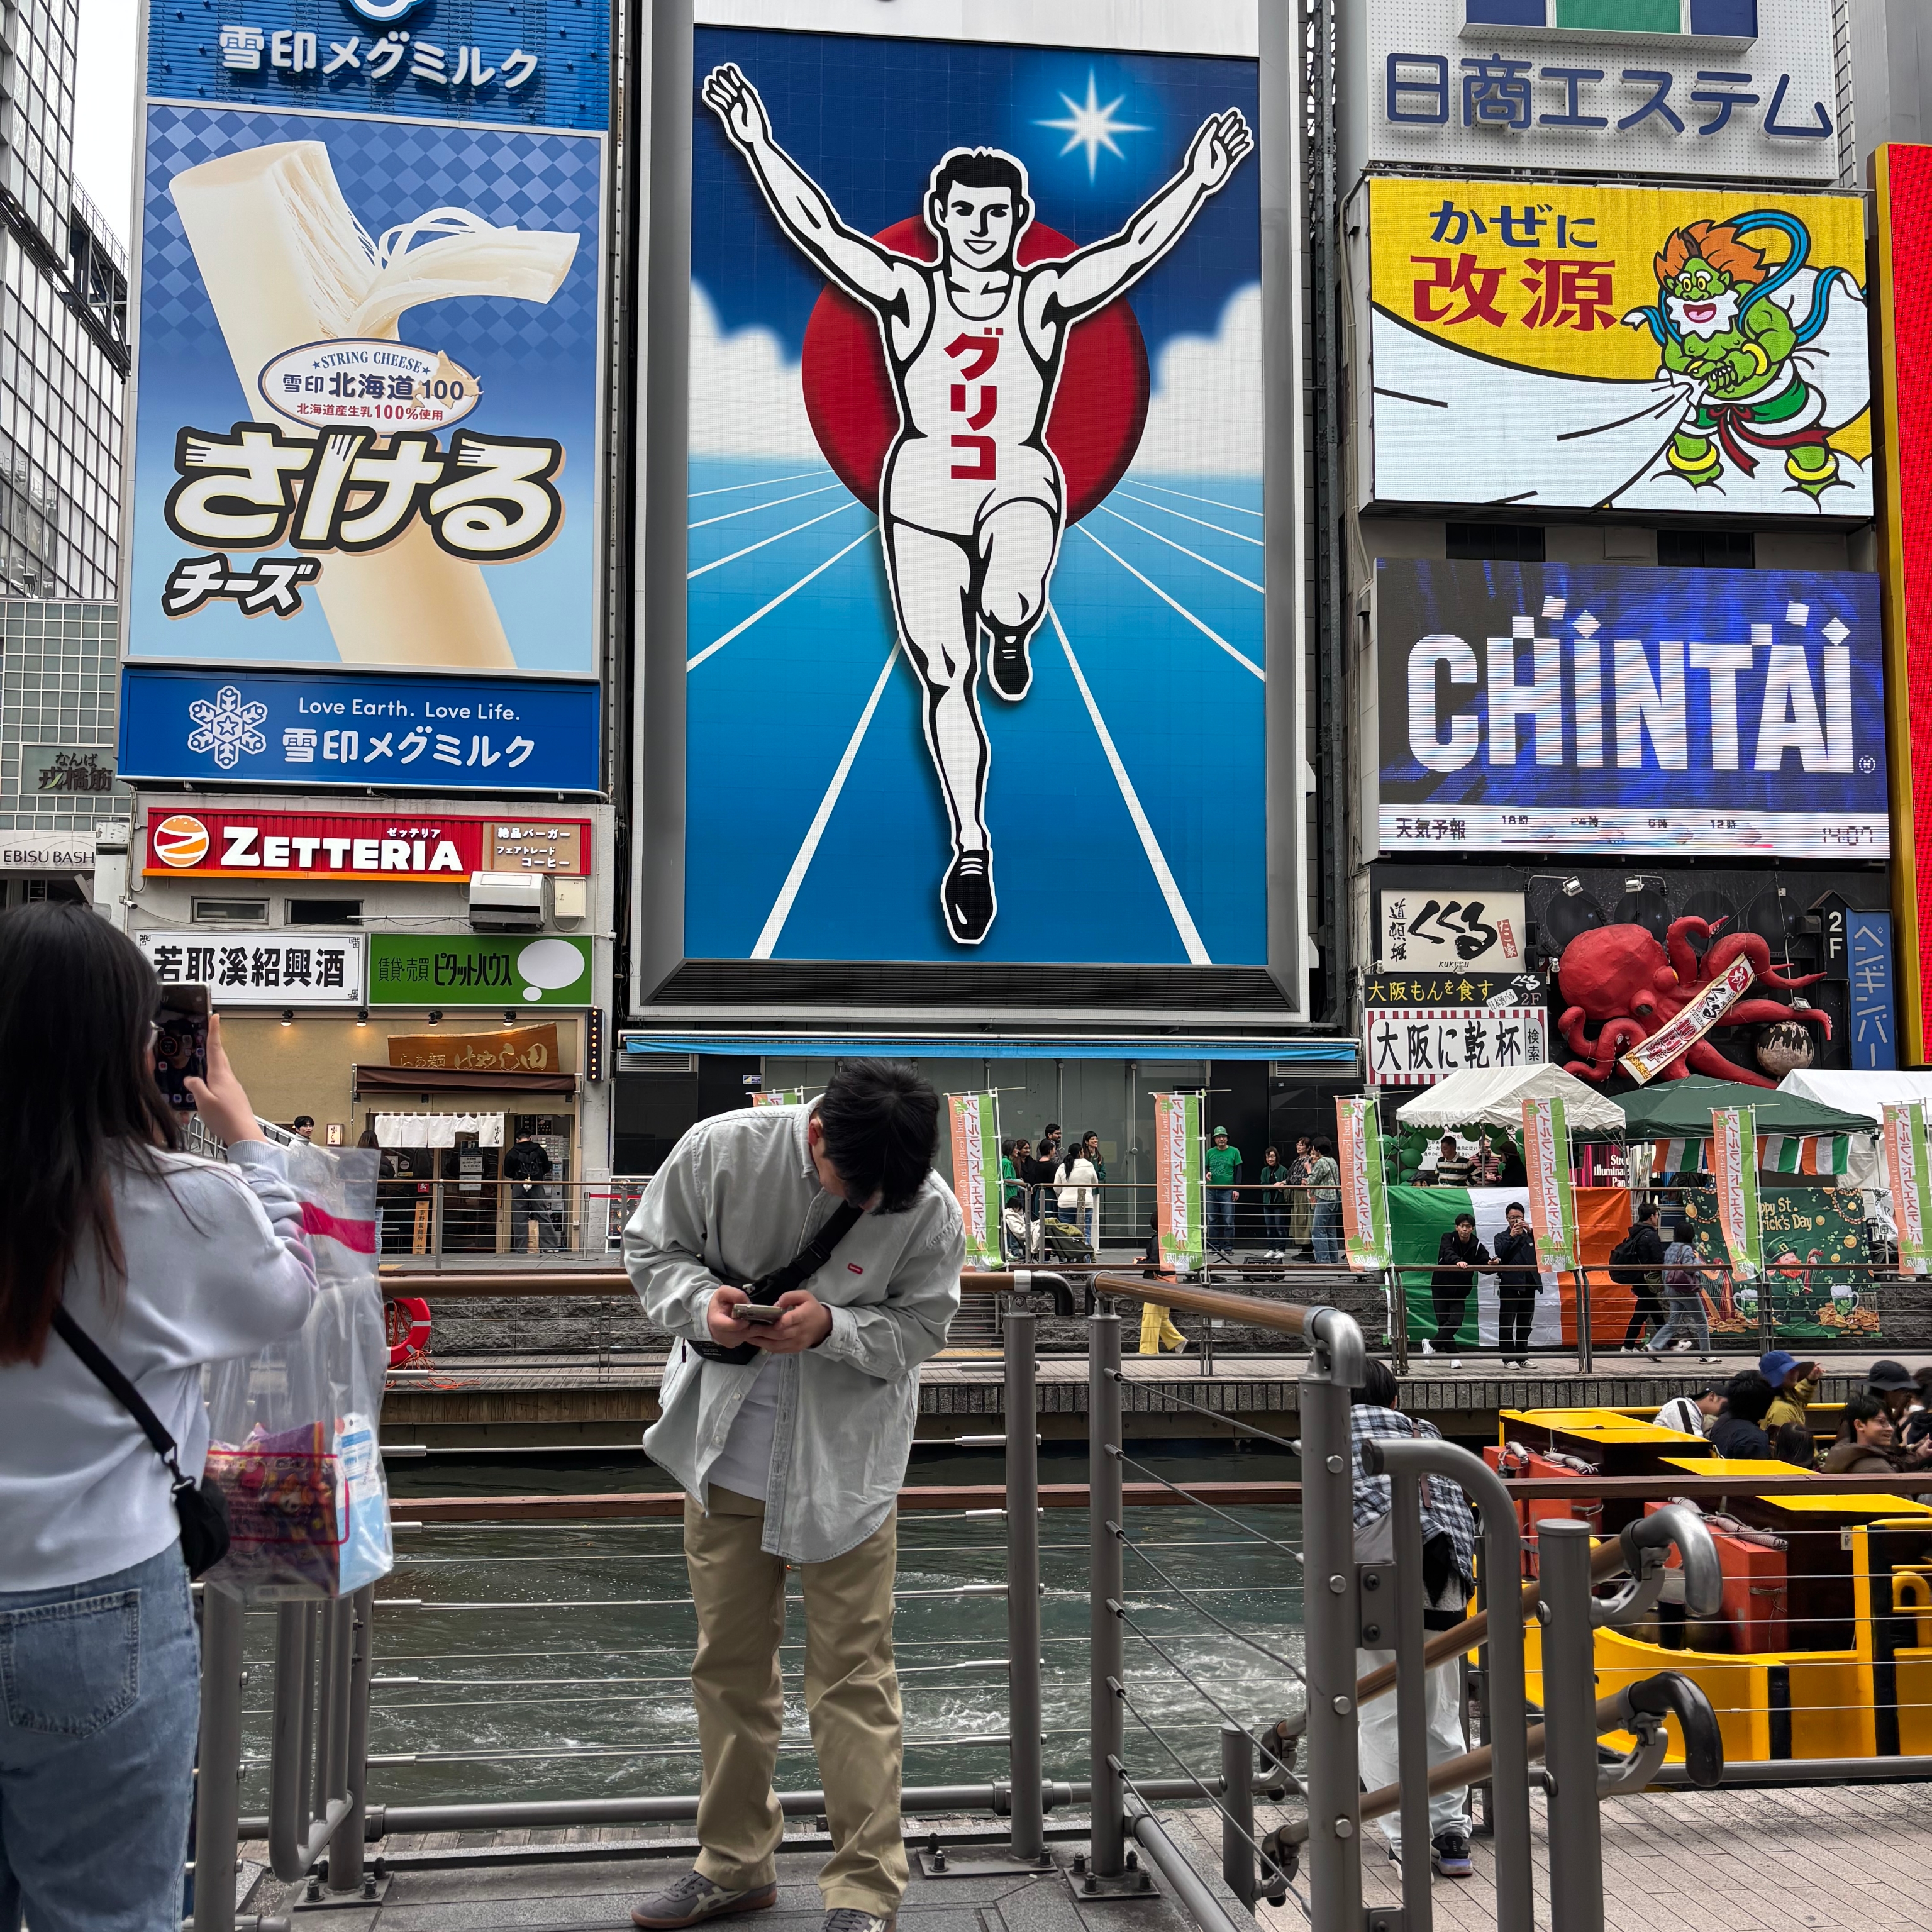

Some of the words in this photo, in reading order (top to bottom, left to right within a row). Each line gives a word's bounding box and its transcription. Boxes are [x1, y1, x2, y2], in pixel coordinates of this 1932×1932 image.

[219, 25, 540, 90] 雪印メグミルク
[1386, 52, 1833, 139] 日商エステム
[1429, 199, 1599, 249] かぜに
[1410, 253, 1622, 331] 改源
[321, 351, 369, 369] STRING
[373, 351, 423, 374] CHEESE
[297, 403, 443, 421] 北海道産生乳100%使用
[943, 327, 1004, 480] グリコ
[167, 425, 559, 558] さける
[166, 556, 319, 614] チーズ
[1407, 610, 1855, 773] CHINTAI
[299, 699, 345, 716] Love
[352, 700, 415, 717] Earth.
[426, 702, 472, 719] Love
[477, 703, 521, 720] Life.
[282, 726, 535, 769] 雪印メグミルク
[55, 752, 98, 768] なんば
[38, 766, 114, 792] 戎橋筋
[387, 827, 441, 838] ゼッテリア
[497, 827, 570, 840] 絶品バーガー
[1396, 818, 1466, 841] 天気予報
[3, 850, 49, 864] EBISU
[221, 826, 464, 872] ZETTERIA
[496, 845, 556, 856] フェアトレード
[521, 857, 570, 869] コーヒー
[1389, 898, 1407, 962] 道頓堀
[1407, 900, 1498, 960] くくる
[1498, 921, 1518, 958] たこ家
[434, 953, 513, 987] ピタットハウス
[1729, 967, 1747, 990] 祝
[1368, 979, 1494, 1001] 大阪もんを食す
[1511, 975, 1540, 991] くくる
[1488, 992, 1514, 1010] 日本酒バル
[1521, 992, 1541, 1006] 2F
[1854, 926, 1887, 1067] ペンギンバー
[1377, 1020, 1520, 1070] 大阪に乾杯
[1527, 1028, 1540, 1062] 検索
[1612, 1177, 1631, 1188] Pan
[1760, 1202, 1775, 1216] ppy
[1778, 1197, 1799, 1213] St.
[1761, 1214, 1790, 1231] rick's
[1791, 1213, 1812, 1231] Day
